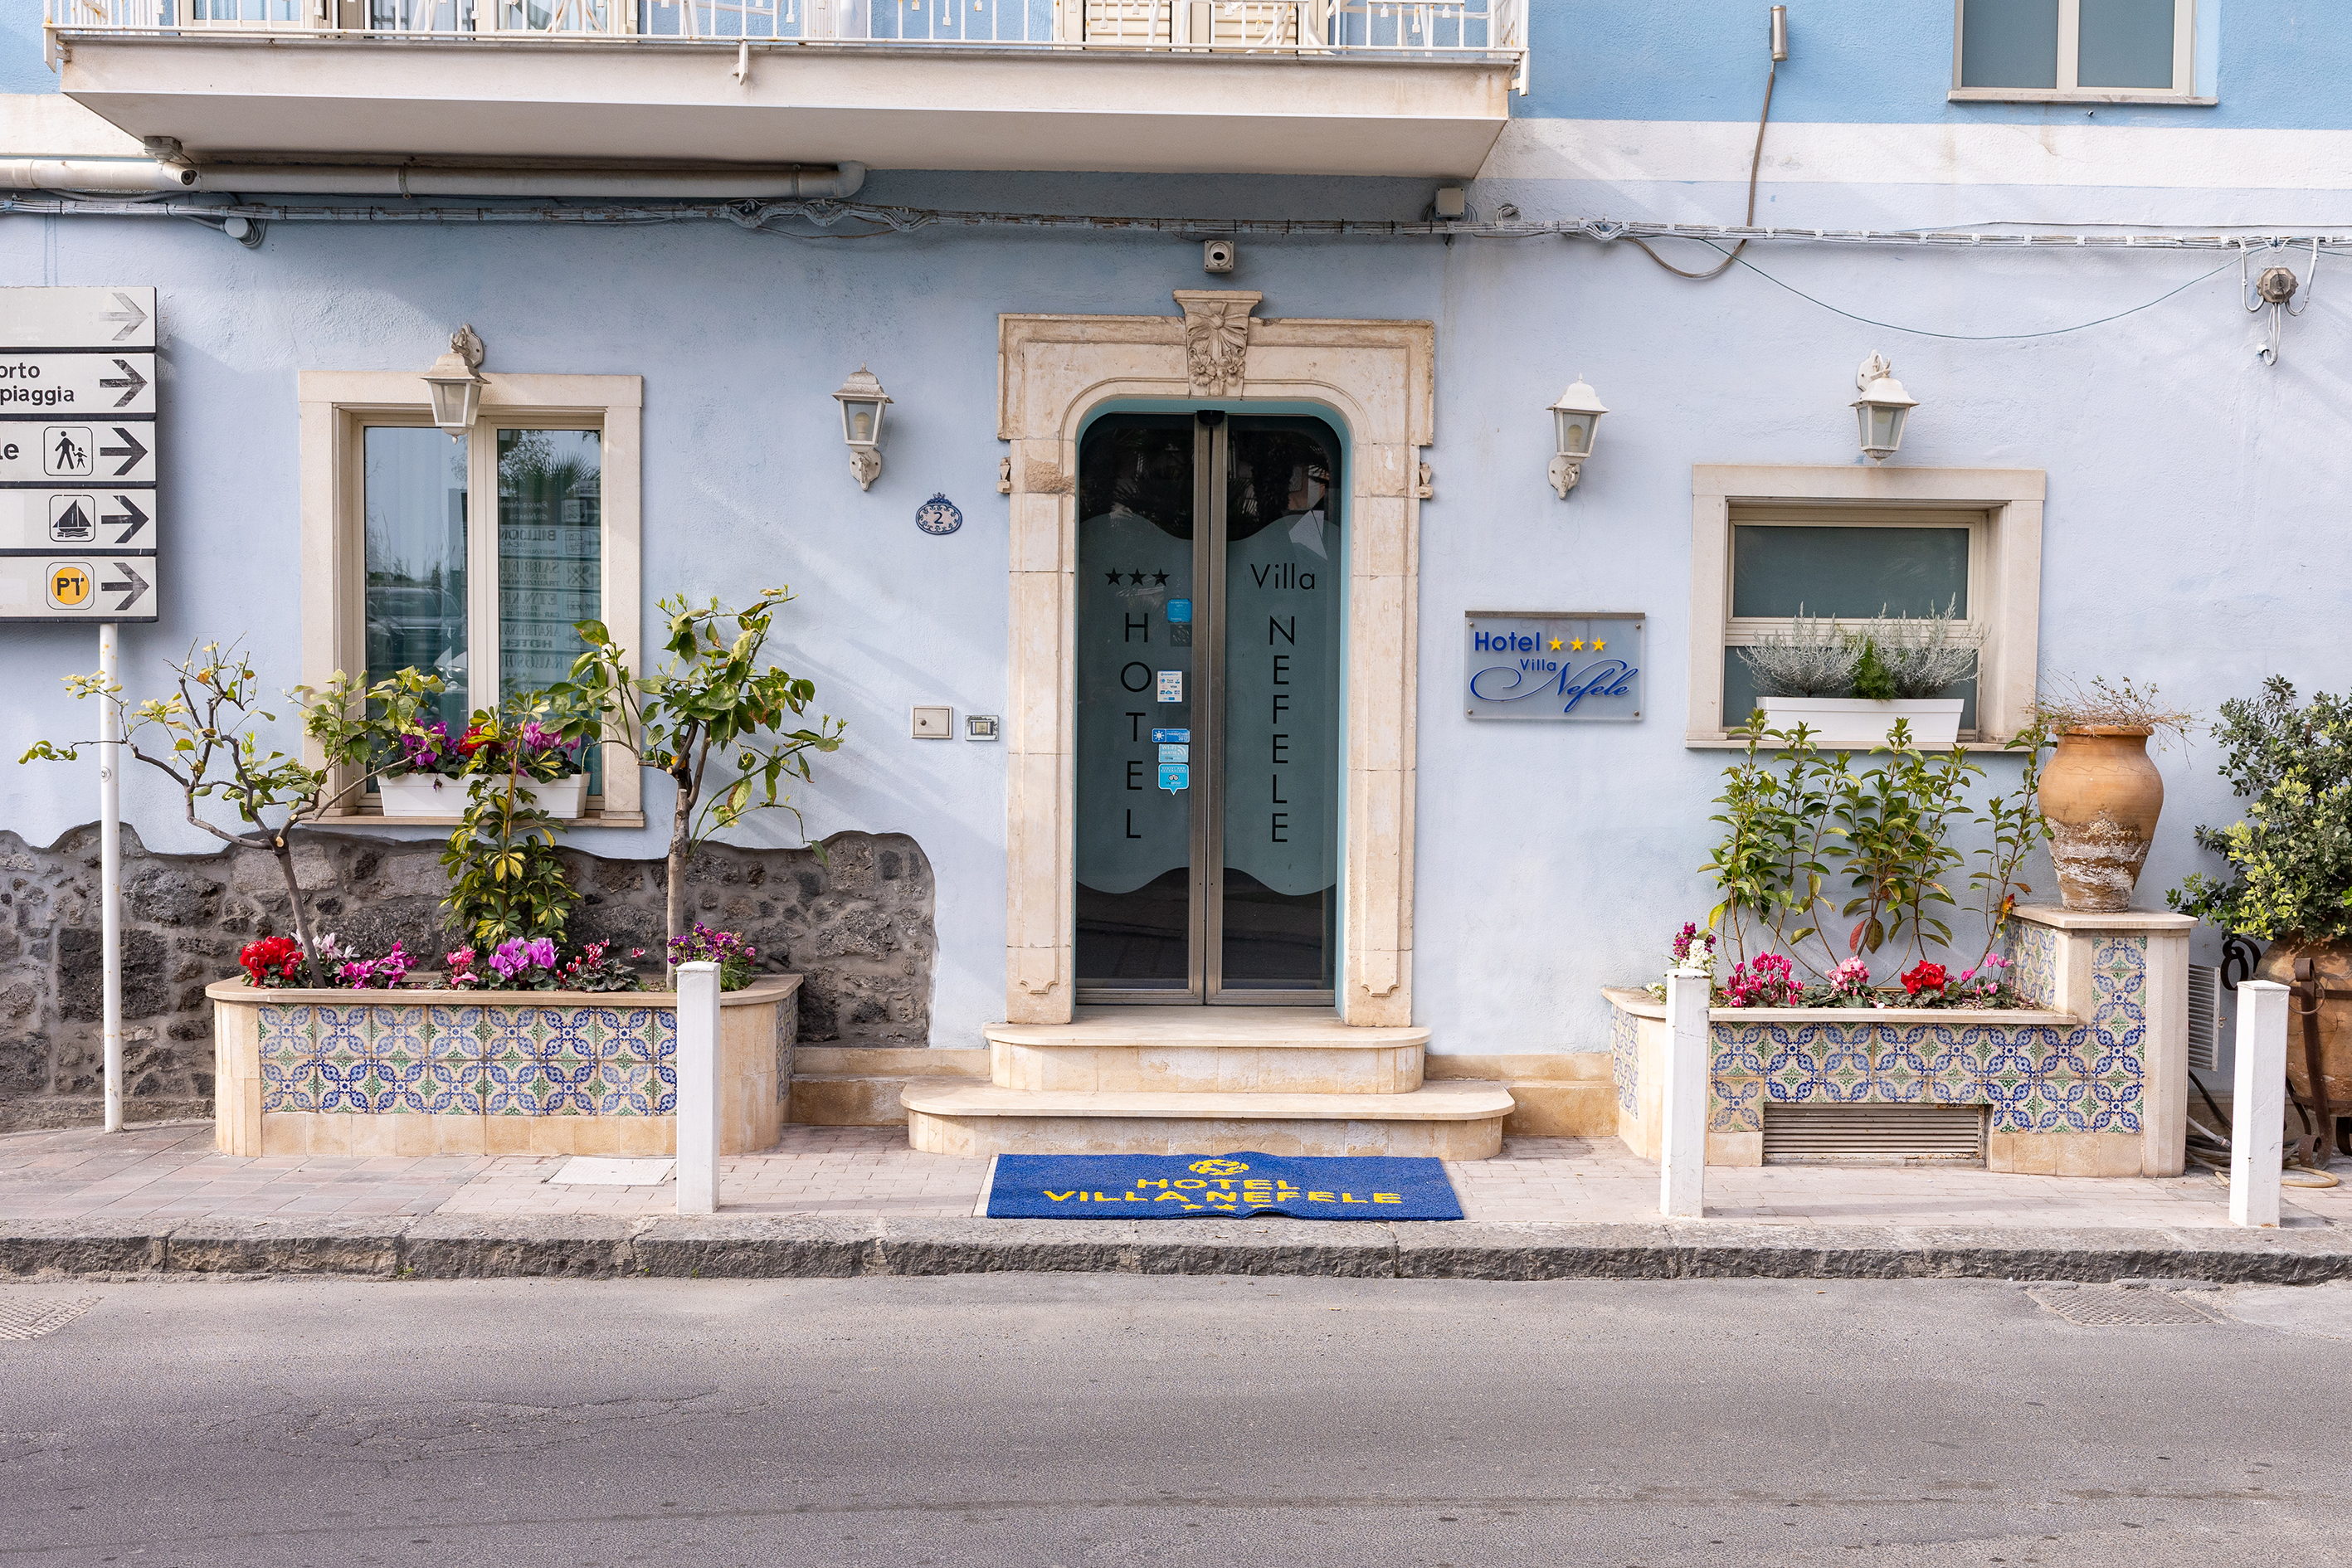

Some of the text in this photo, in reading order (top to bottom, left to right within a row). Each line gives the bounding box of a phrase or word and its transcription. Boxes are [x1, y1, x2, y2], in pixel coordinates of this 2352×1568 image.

[933, 511, 944, 524] 2
[1250, 562, 1316, 590] Villa
[56, 577, 85, 597] PT
[1474, 631, 1541, 652] Hotel
[1519, 659, 1557, 672] Villa
[1470, 659, 1639, 713] Nefele
[1120, 612, 1152, 839] HOTEL
[1269, 615, 1296, 843] NEFELE
[1137, 1178, 1300, 1190] HOTEL
[1043, 1191, 1403, 1204] VILLA NEFELE
